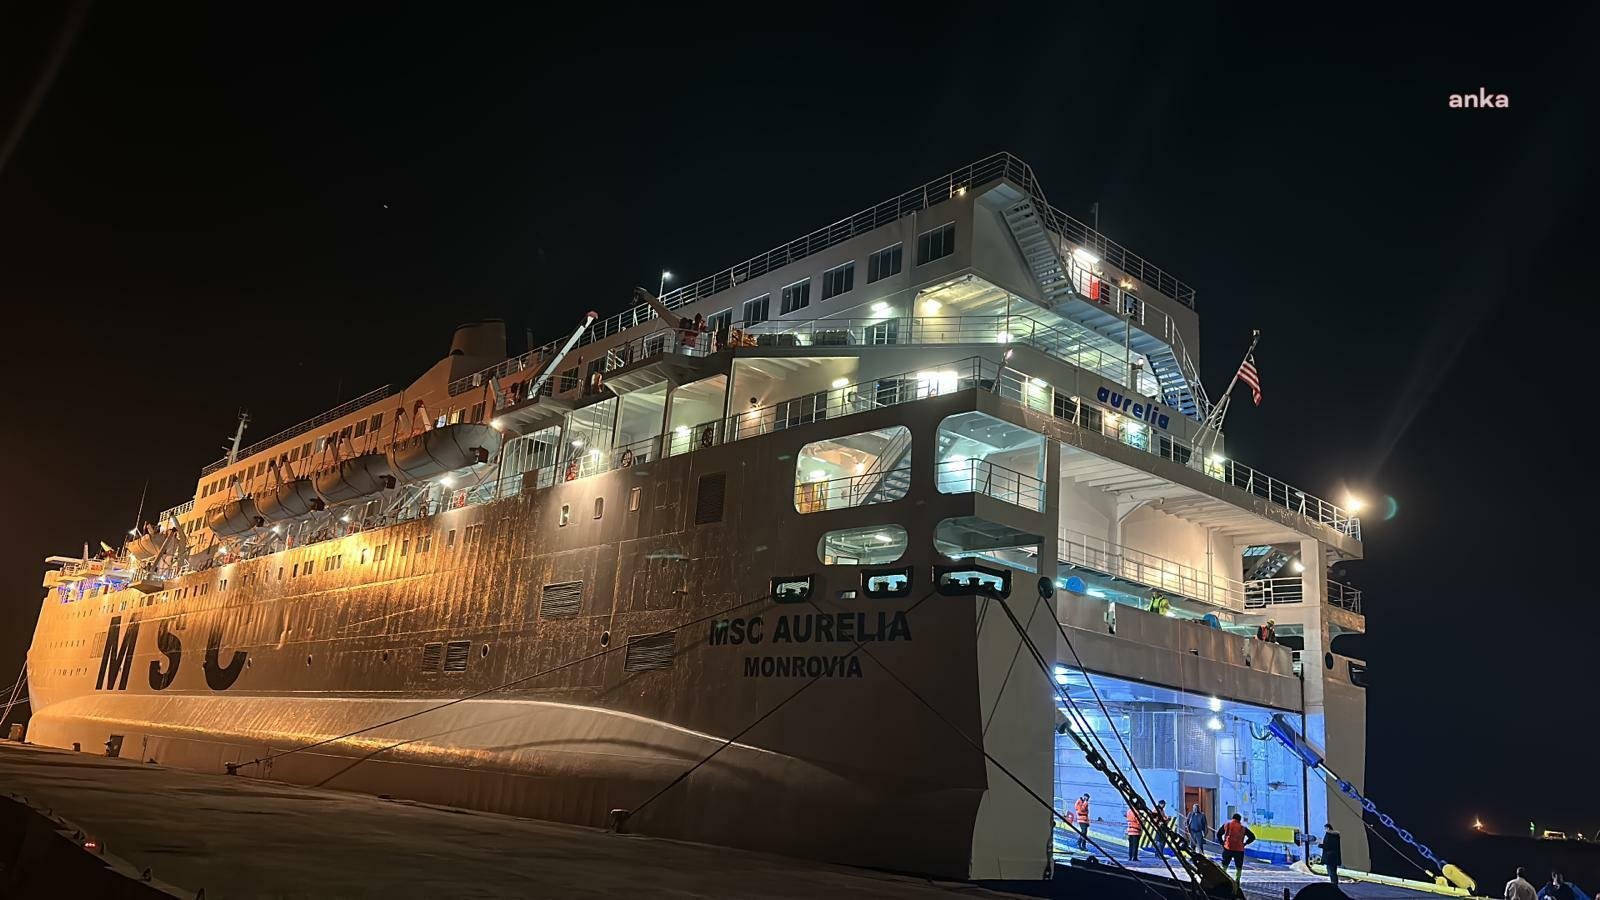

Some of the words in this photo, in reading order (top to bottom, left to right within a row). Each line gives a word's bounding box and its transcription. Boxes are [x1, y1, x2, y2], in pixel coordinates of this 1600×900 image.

[1097, 386, 1169, 430] aurelia
[709, 617, 764, 646] MSC
[772, 611, 912, 643] AURELIA
[95, 612, 248, 690] MSC
[744, 656, 863, 678] MONROVIA
